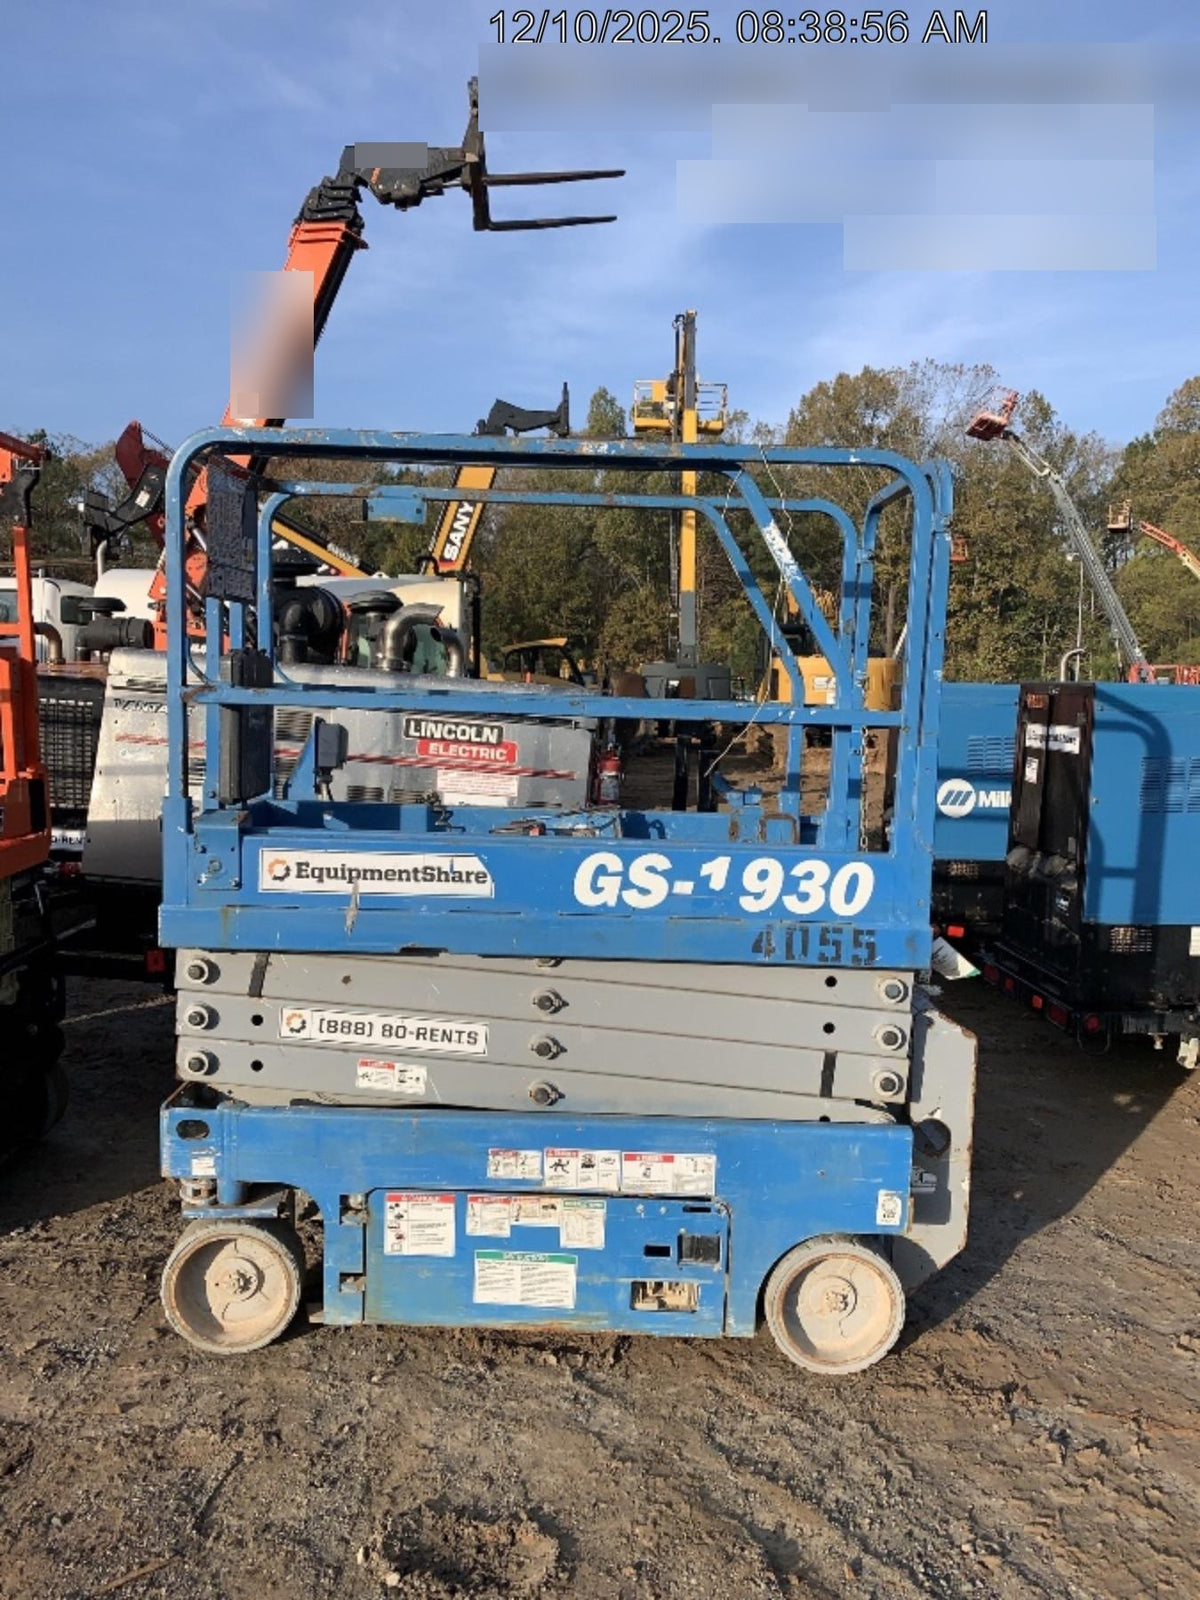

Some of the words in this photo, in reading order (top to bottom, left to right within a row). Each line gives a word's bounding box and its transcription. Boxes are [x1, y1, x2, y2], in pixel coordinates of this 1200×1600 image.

[443, 501, 474, 561] SANY
[408, 719, 499, 744] LINCOLN
[428, 742, 508, 761] ELECTRIC
[295, 861, 488, 884] EquipmentShare
[574, 851, 875, 917] GS-1930
[751, 924, 877, 966] 4055
[381, 1023, 479, 1046] 80-RENTS
